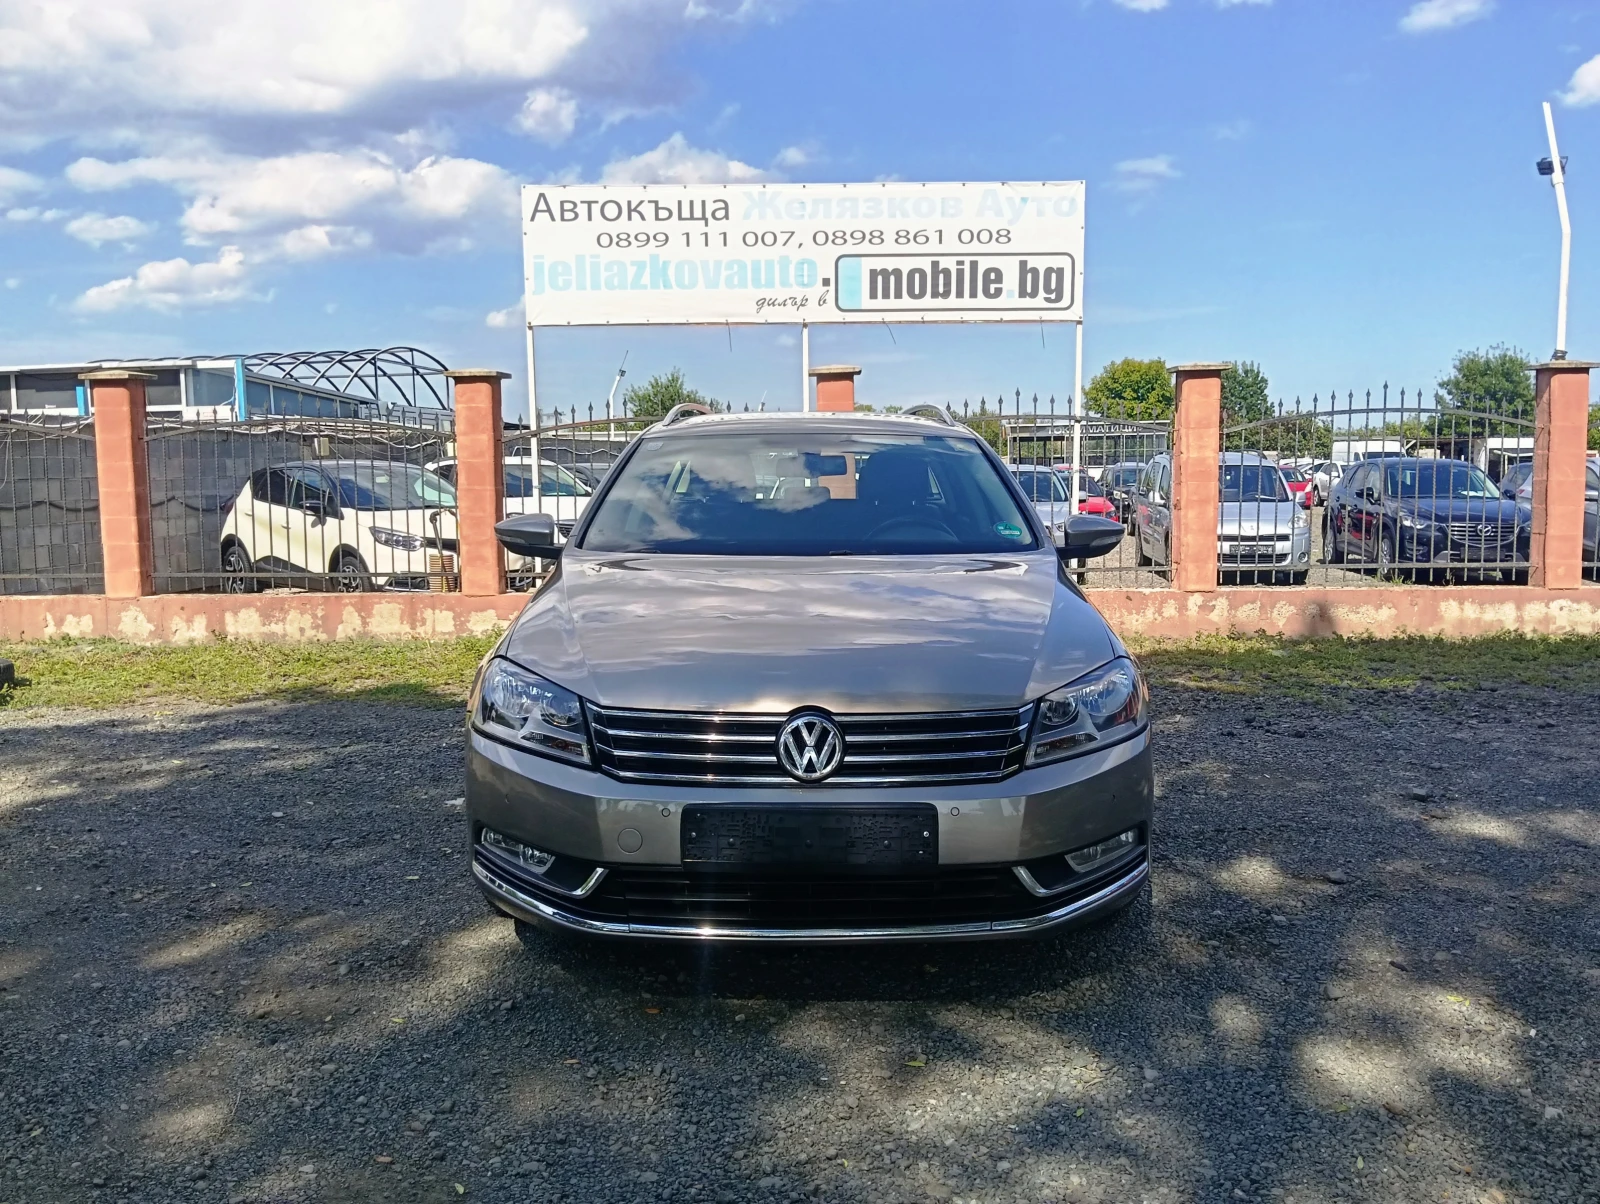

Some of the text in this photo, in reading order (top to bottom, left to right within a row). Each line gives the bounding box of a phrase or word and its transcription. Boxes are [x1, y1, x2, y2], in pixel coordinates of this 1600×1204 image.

[530, 189, 1079, 227] Автокъща Желязков Ауто
[596, 229, 1012, 249] 0899 111 007, 0898 861 008
[868, 259, 1065, 304] mobile.bg
[755, 289, 830, 314] дилър в
